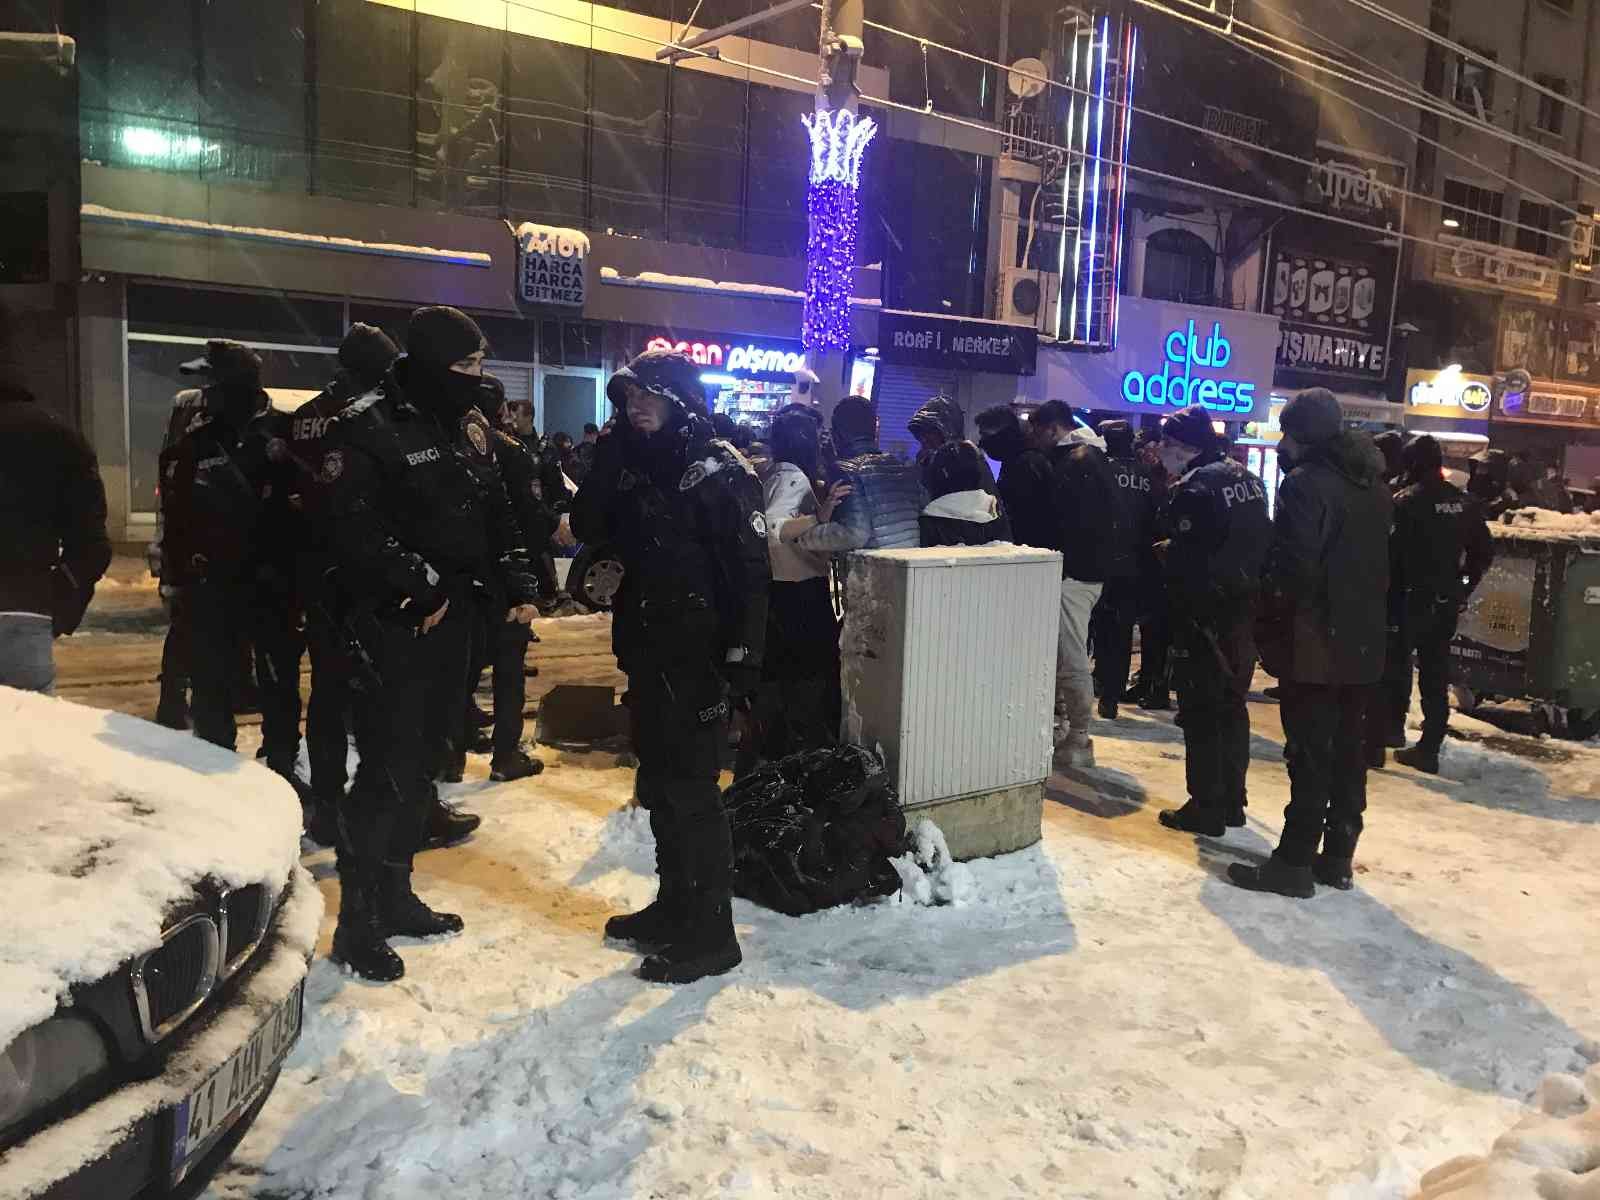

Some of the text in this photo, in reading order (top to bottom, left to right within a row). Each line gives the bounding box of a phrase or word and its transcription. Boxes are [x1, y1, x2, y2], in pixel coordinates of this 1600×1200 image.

[525, 257, 583, 277] HARCA
[525, 271, 583, 290] HARCA
[524, 285, 583, 303] BİTMEZ
[1164, 319, 1232, 368] club
[1278, 329, 1384, 371] İŞMANİYE
[726, 344, 806, 373] pişma
[1122, 361, 1256, 414] address
[1115, 473, 1151, 492] OLİS
[188, 1079, 216, 1140] 41
